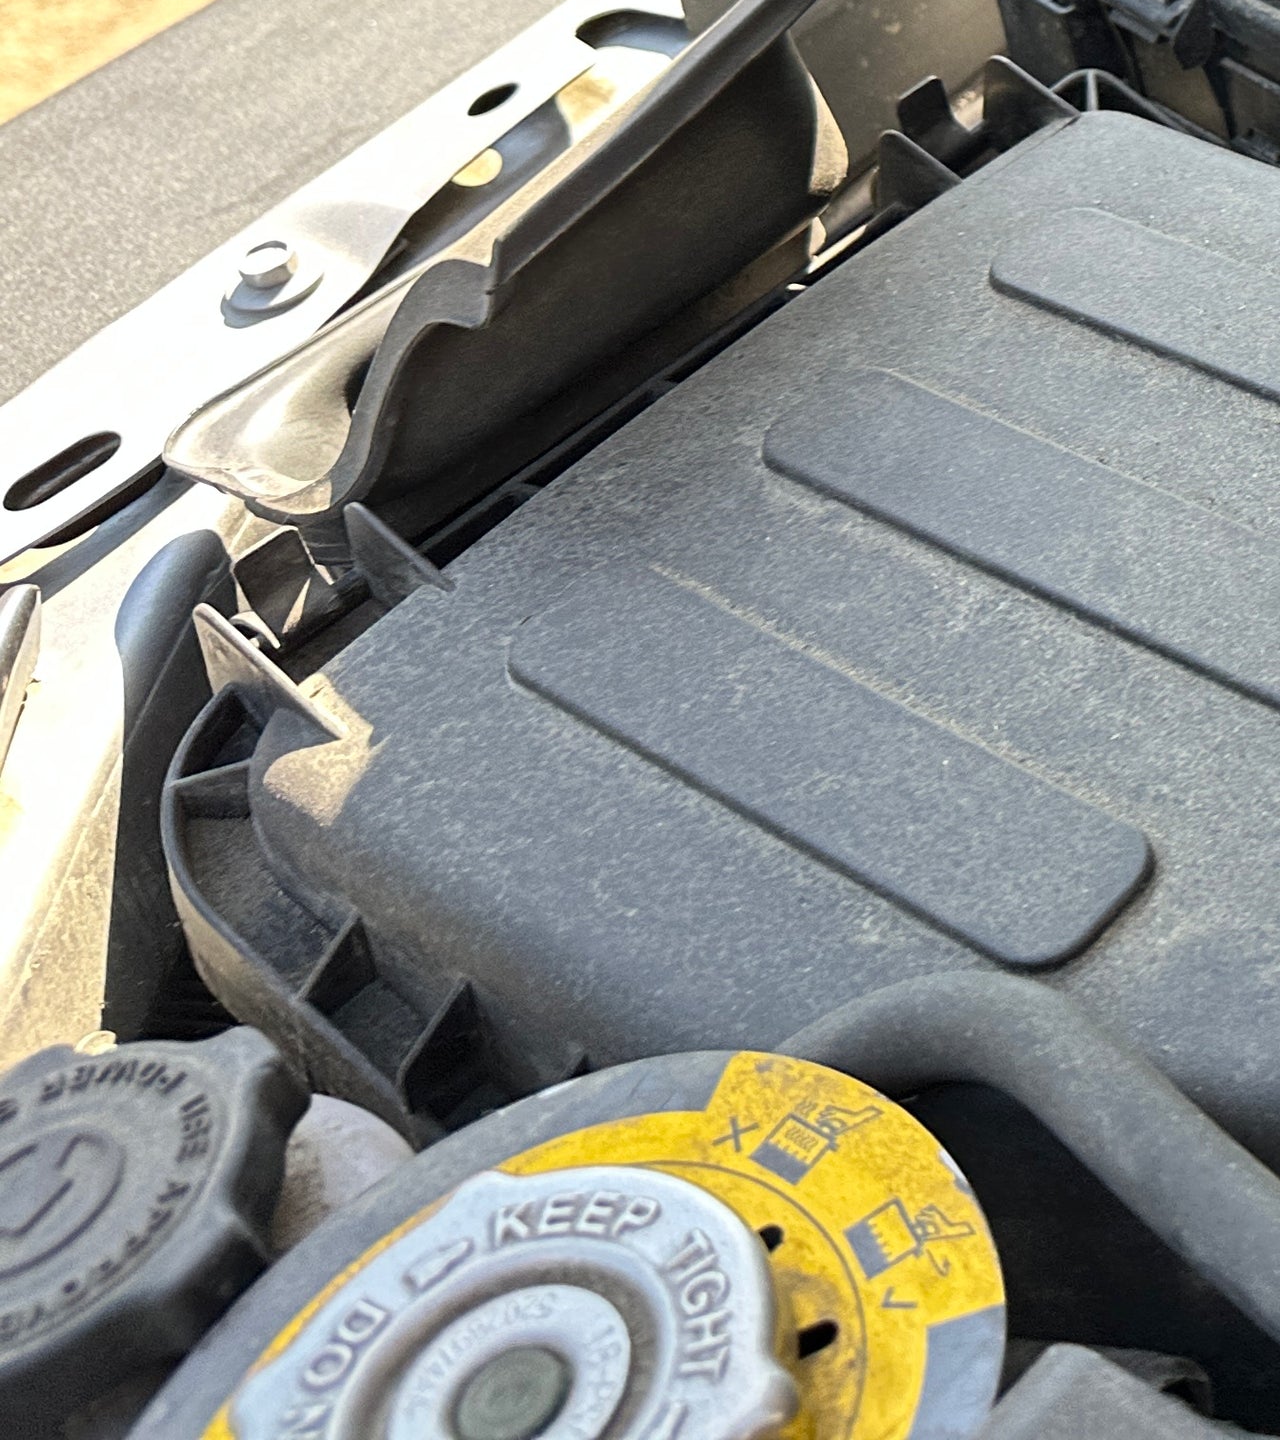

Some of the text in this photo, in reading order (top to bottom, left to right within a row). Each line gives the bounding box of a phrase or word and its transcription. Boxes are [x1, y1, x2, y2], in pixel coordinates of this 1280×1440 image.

[39, 1059, 188, 1104] POWER
[176, 1094, 212, 1162] USE
[489, 1189, 661, 1248] KEEP
[662, 1227, 733, 1385] TIGHT
